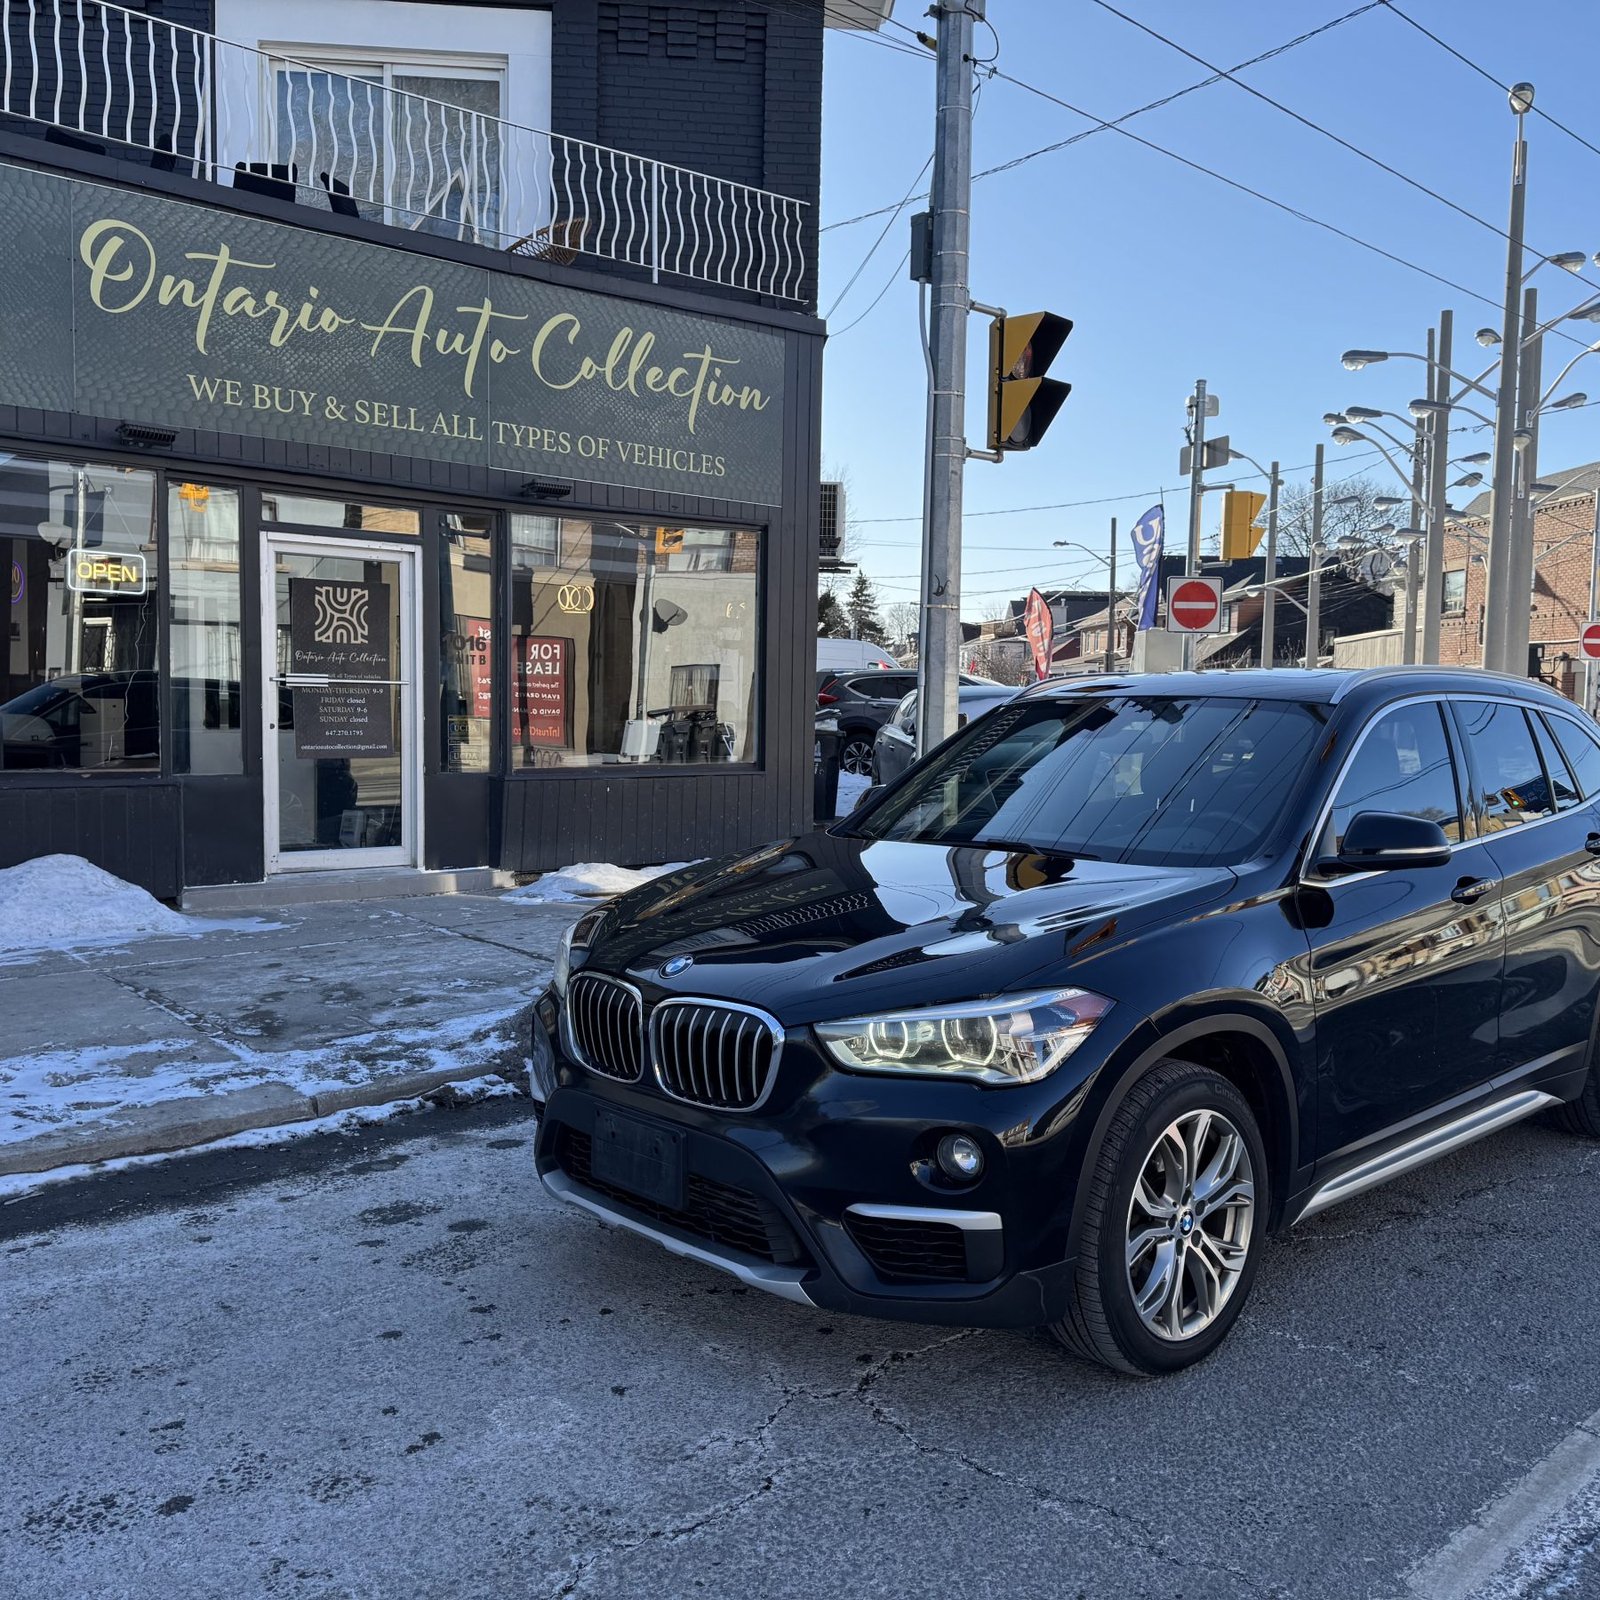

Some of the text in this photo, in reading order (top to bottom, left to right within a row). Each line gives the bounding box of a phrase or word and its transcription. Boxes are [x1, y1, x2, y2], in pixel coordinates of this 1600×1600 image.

[80, 218, 771, 436] Ontario Auto Collection
[186, 373, 726, 477] WE BUY & SELL ALL TYPES OF VEHICLES
[77, 562, 137, 582] OPEN
[295, 650, 387, 666] Ontario Auto Collection
[479, 655, 487, 665] B
[301, 687, 371, 695] MONDAY-THURSDAY
[320, 696, 345, 704] FRIDAY
[319, 706, 355, 714] SATURDAY
